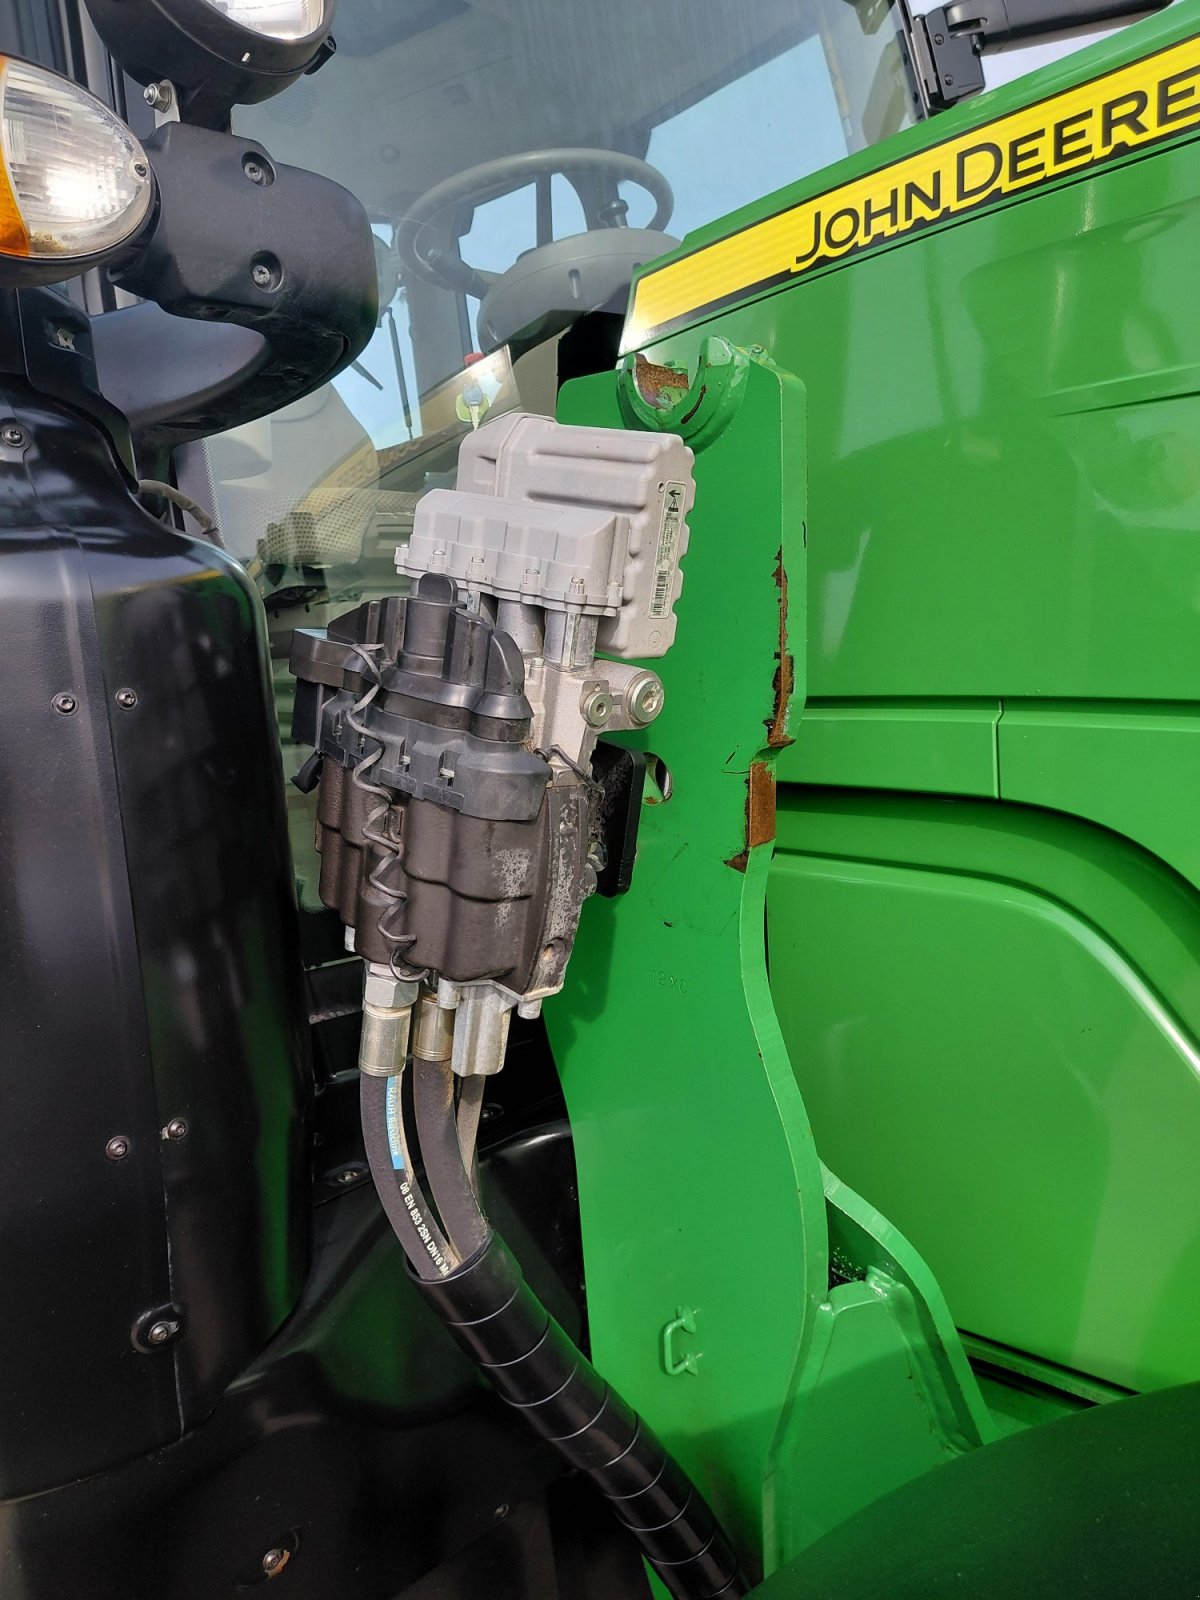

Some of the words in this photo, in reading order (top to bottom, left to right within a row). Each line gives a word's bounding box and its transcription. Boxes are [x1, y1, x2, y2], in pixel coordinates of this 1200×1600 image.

[796, 170, 941, 263] JOHN
[957, 69, 1200, 201] DEERE
[400, 1181, 409, 1195] 08
[404, 1194, 416, 1210] EN
[411, 1207, 424, 1226] 853
[417, 1223, 432, 1245] 2SN
[427, 1241, 445, 1267] DN16
